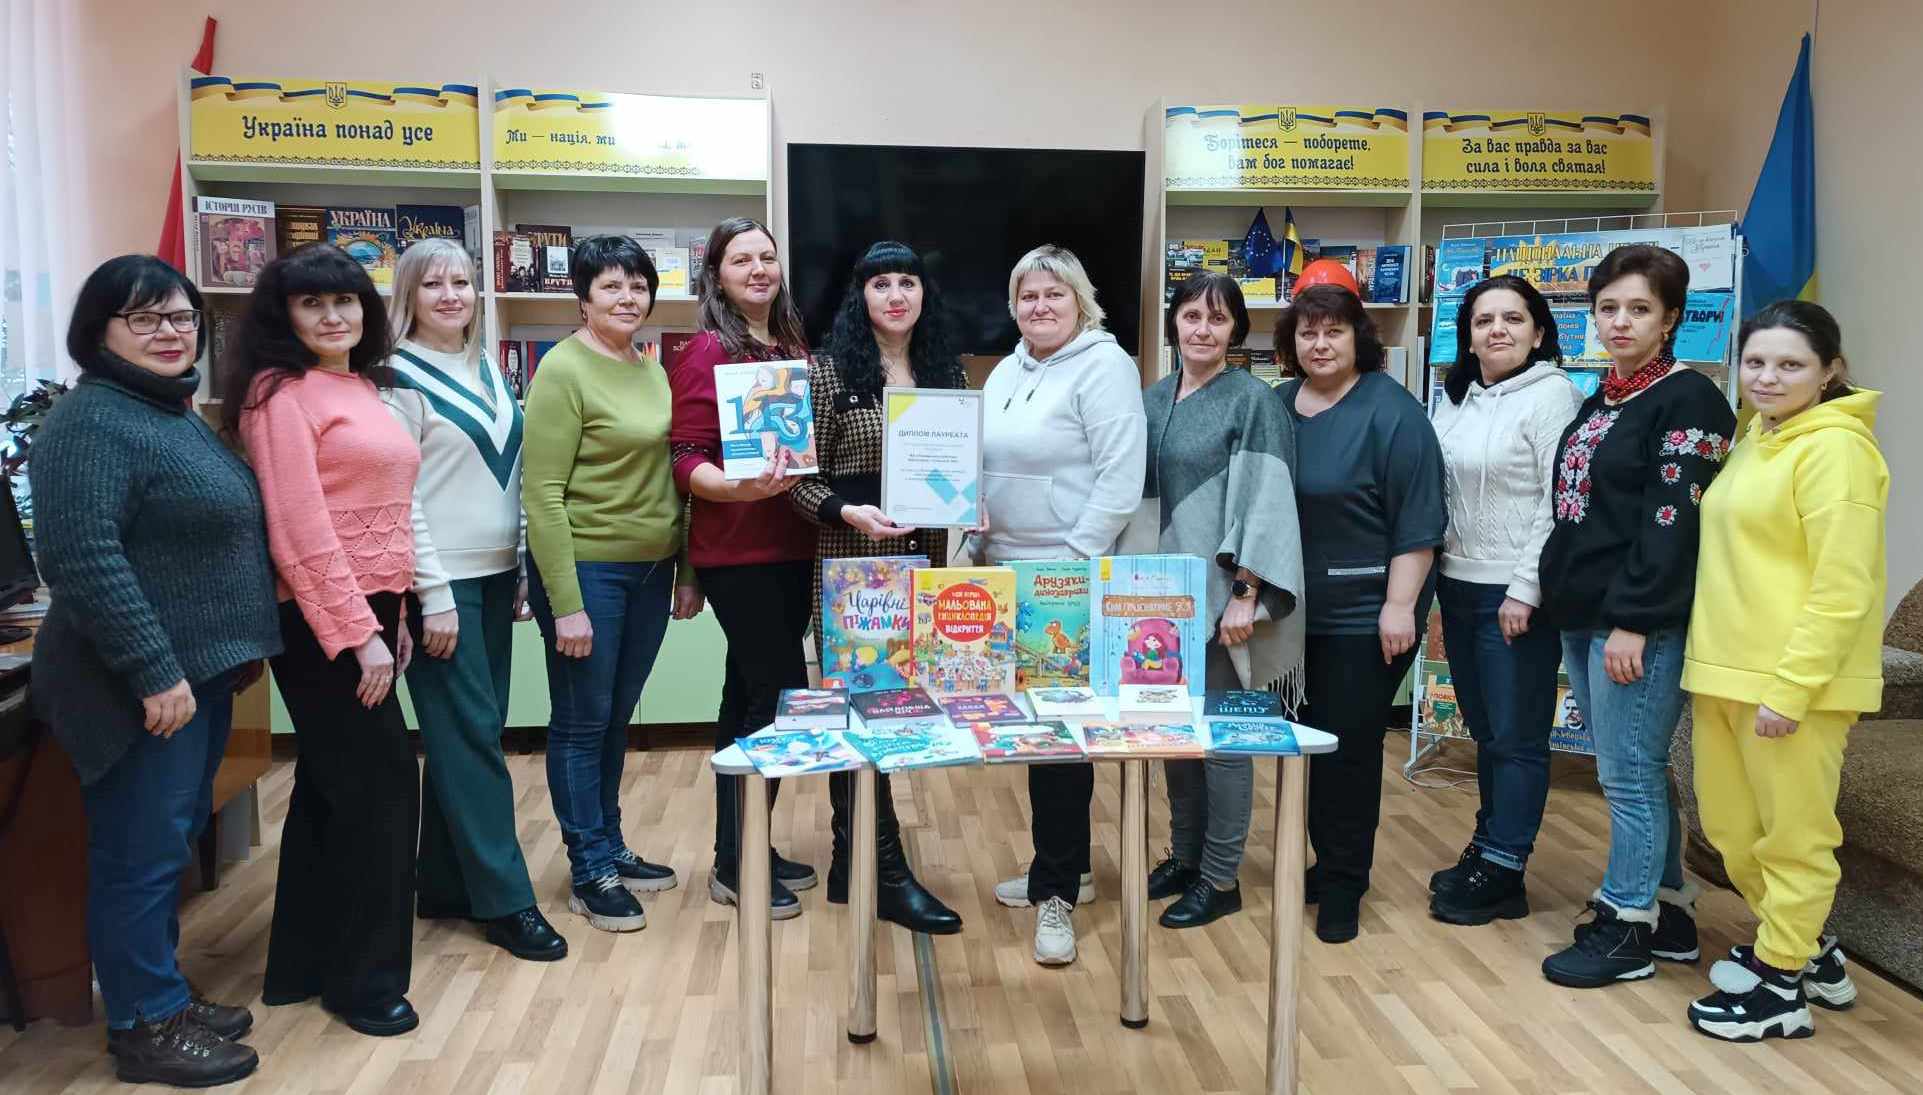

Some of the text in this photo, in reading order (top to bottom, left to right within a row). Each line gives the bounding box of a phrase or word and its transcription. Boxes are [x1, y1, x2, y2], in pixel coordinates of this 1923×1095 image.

[242, 116, 433, 145] Україна понад усе
[1462, 138, 1608, 155] За вас правда за вас
[1263, 154, 1285, 171] бог
[1291, 155, 1355, 171] помагає!
[1466, 159, 1606, 174] сила і воля святая!
[330, 209, 392, 228] УКРАЇНА
[849, 590, 909, 613] Чарівні
